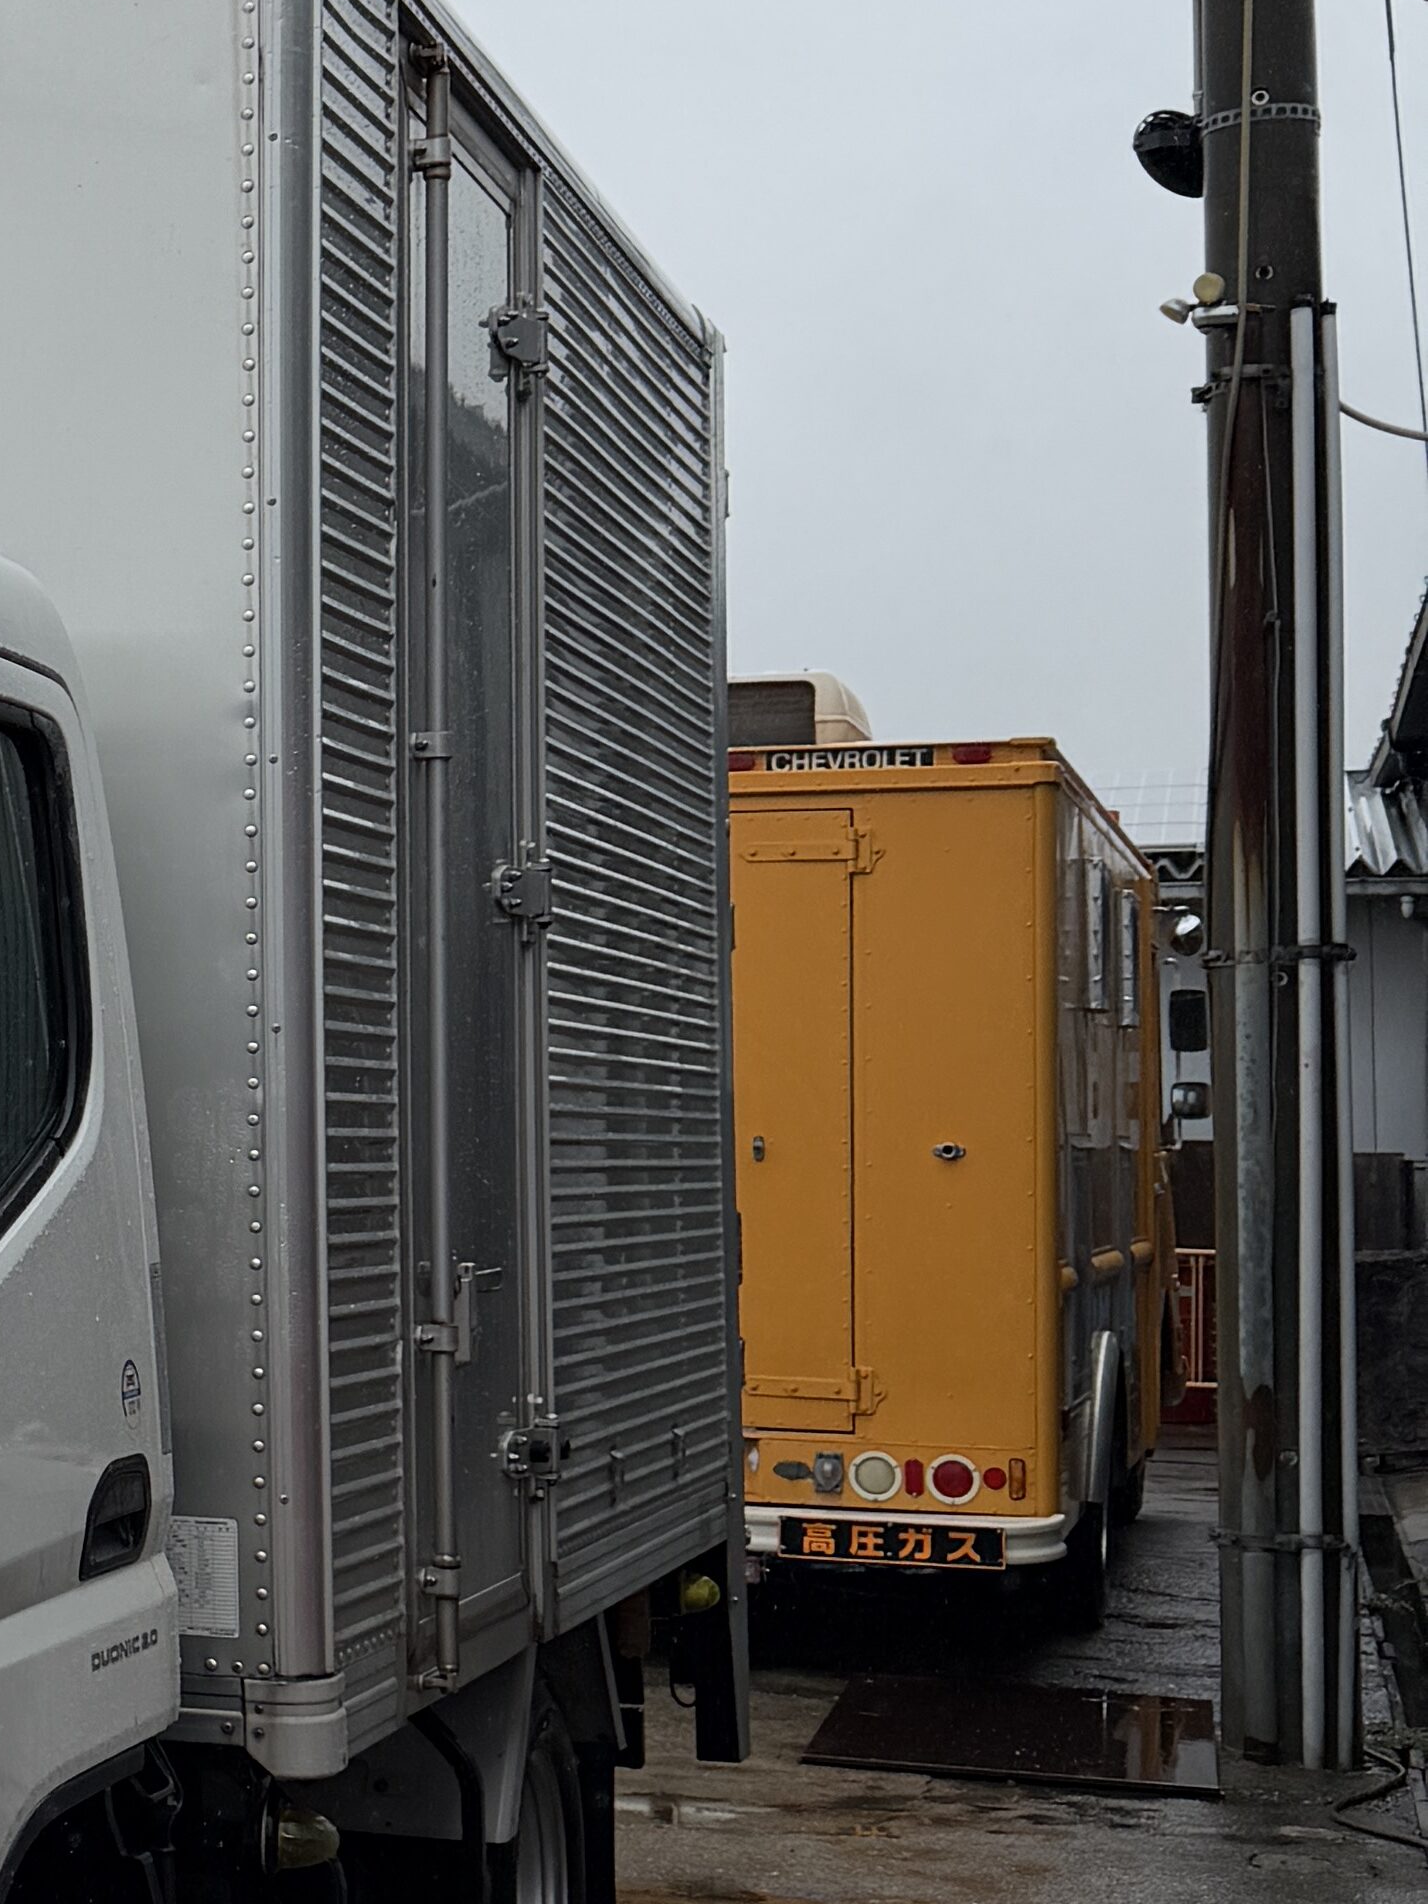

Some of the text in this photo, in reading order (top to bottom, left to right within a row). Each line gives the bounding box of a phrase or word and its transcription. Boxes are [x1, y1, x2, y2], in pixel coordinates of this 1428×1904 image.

[770, 748, 928, 772] CHEVROLET
[801, 1523, 981, 1563] 高圧ガス
[91, 1635, 140, 1673] DUONIC
